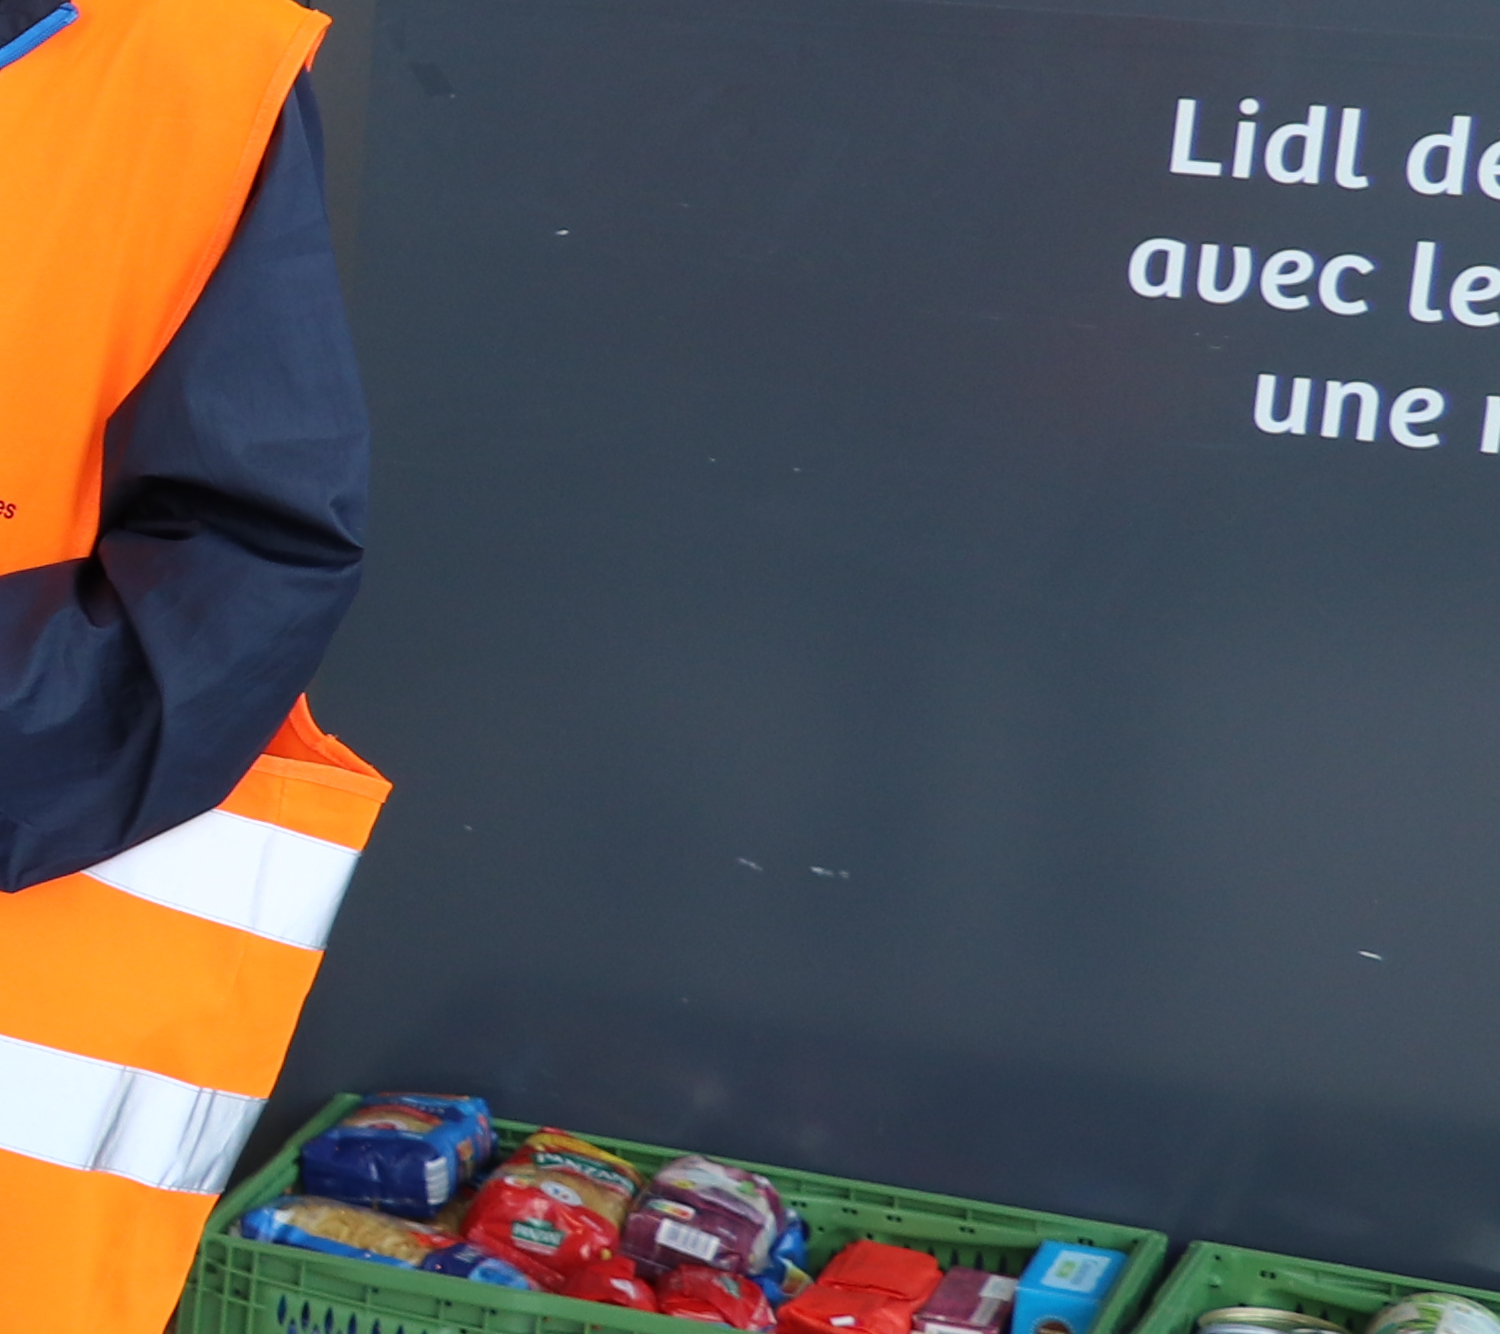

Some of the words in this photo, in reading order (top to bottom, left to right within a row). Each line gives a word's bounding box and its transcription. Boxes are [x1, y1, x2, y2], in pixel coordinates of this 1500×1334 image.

[1169, 96, 1370, 191] Lidl
[1128, 237, 1375, 316] avec
[1253, 372, 1445, 452] une
